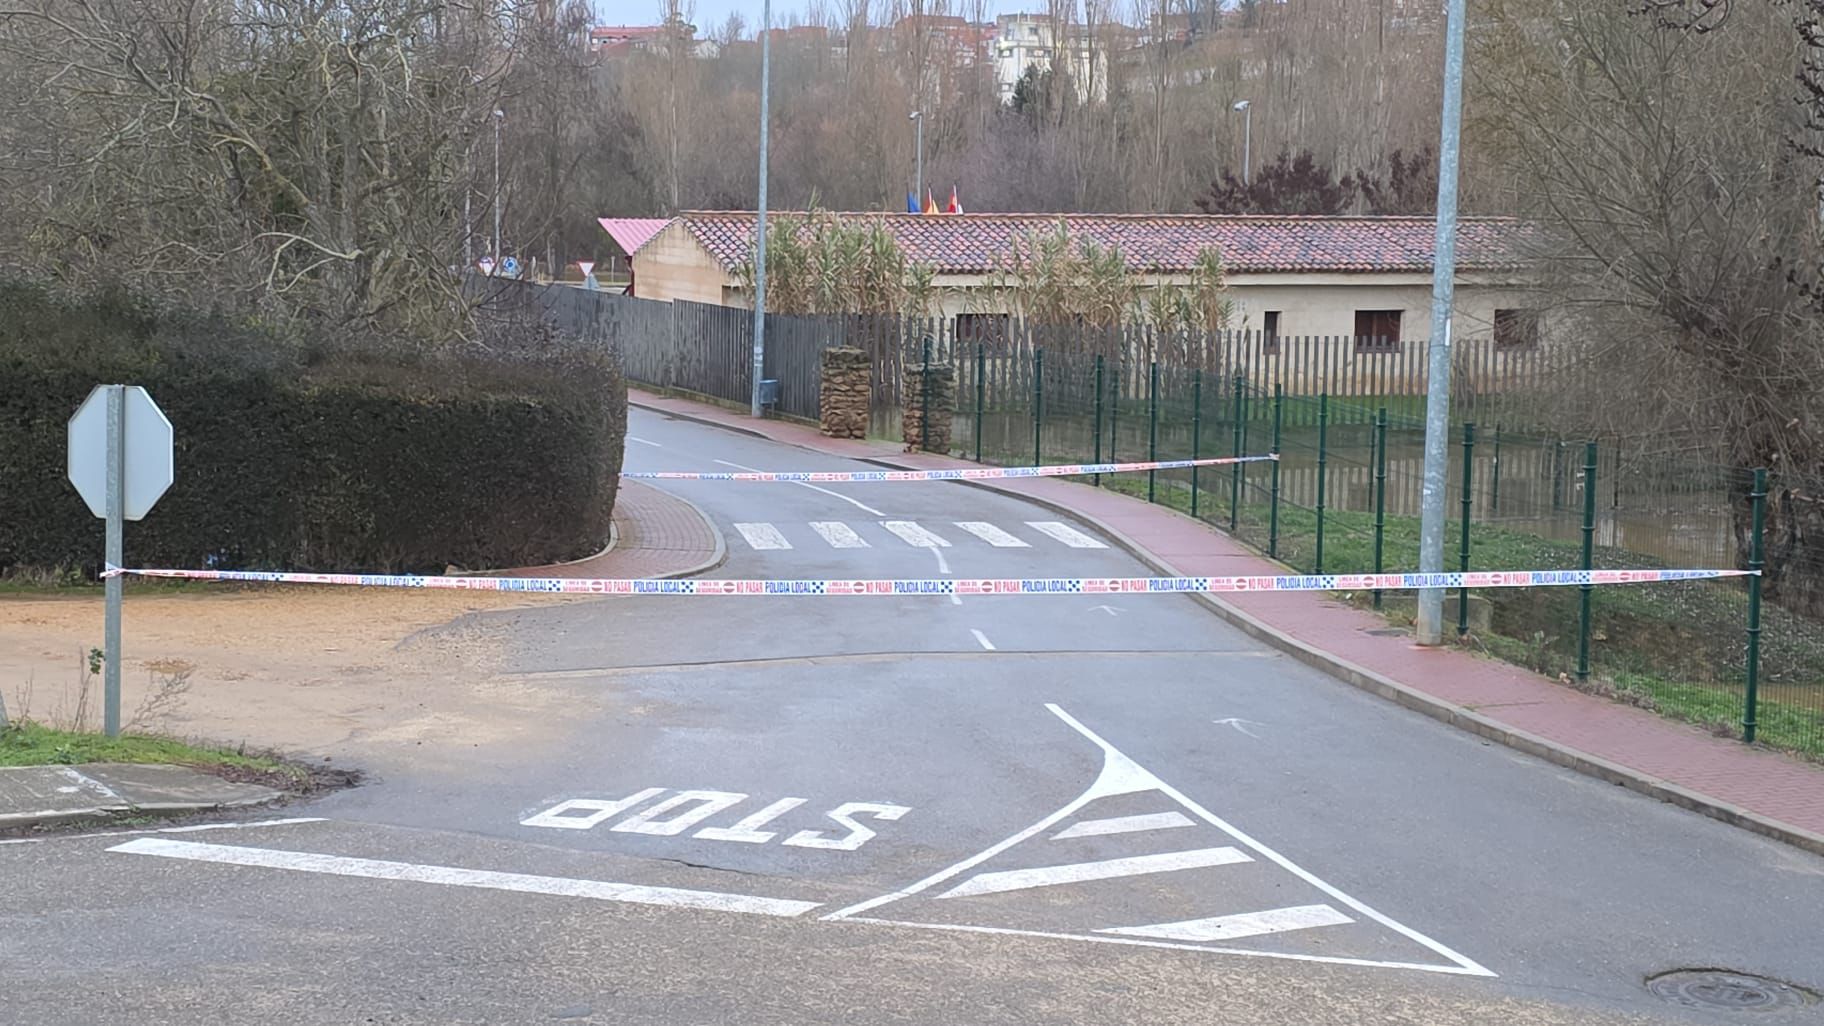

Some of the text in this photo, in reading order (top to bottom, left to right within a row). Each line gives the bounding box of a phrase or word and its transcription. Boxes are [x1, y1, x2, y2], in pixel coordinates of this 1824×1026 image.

[1276, 577, 1321, 589] POLICIA LOCAL
[1376, 576, 1401, 587] NO PASAR
[1429, 575, 1449, 586] LOCAL
[1558, 572, 1577, 583] LOCAL
[604, 582, 631, 592] NO PASAR
[660, 582, 681, 593] LOCAL
[736, 582, 763, 593] NO PASAR
[765, 582, 811, 593] POLICIA LOCAL
[866, 582, 892, 593] NO PASAR
[894, 582, 940, 593] POLICIA LOCAL
[994, 581, 1020, 592] NO PASAR
[1022, 580, 1067, 592] POLICIA LOCAL
[1121, 580, 1147, 591] NO PASAR
[1149, 579, 1194, 591] POLICIA LOCAL
[1248, 578, 1274, 589] NO PASAR
[519, 787, 912, 851] STOP
